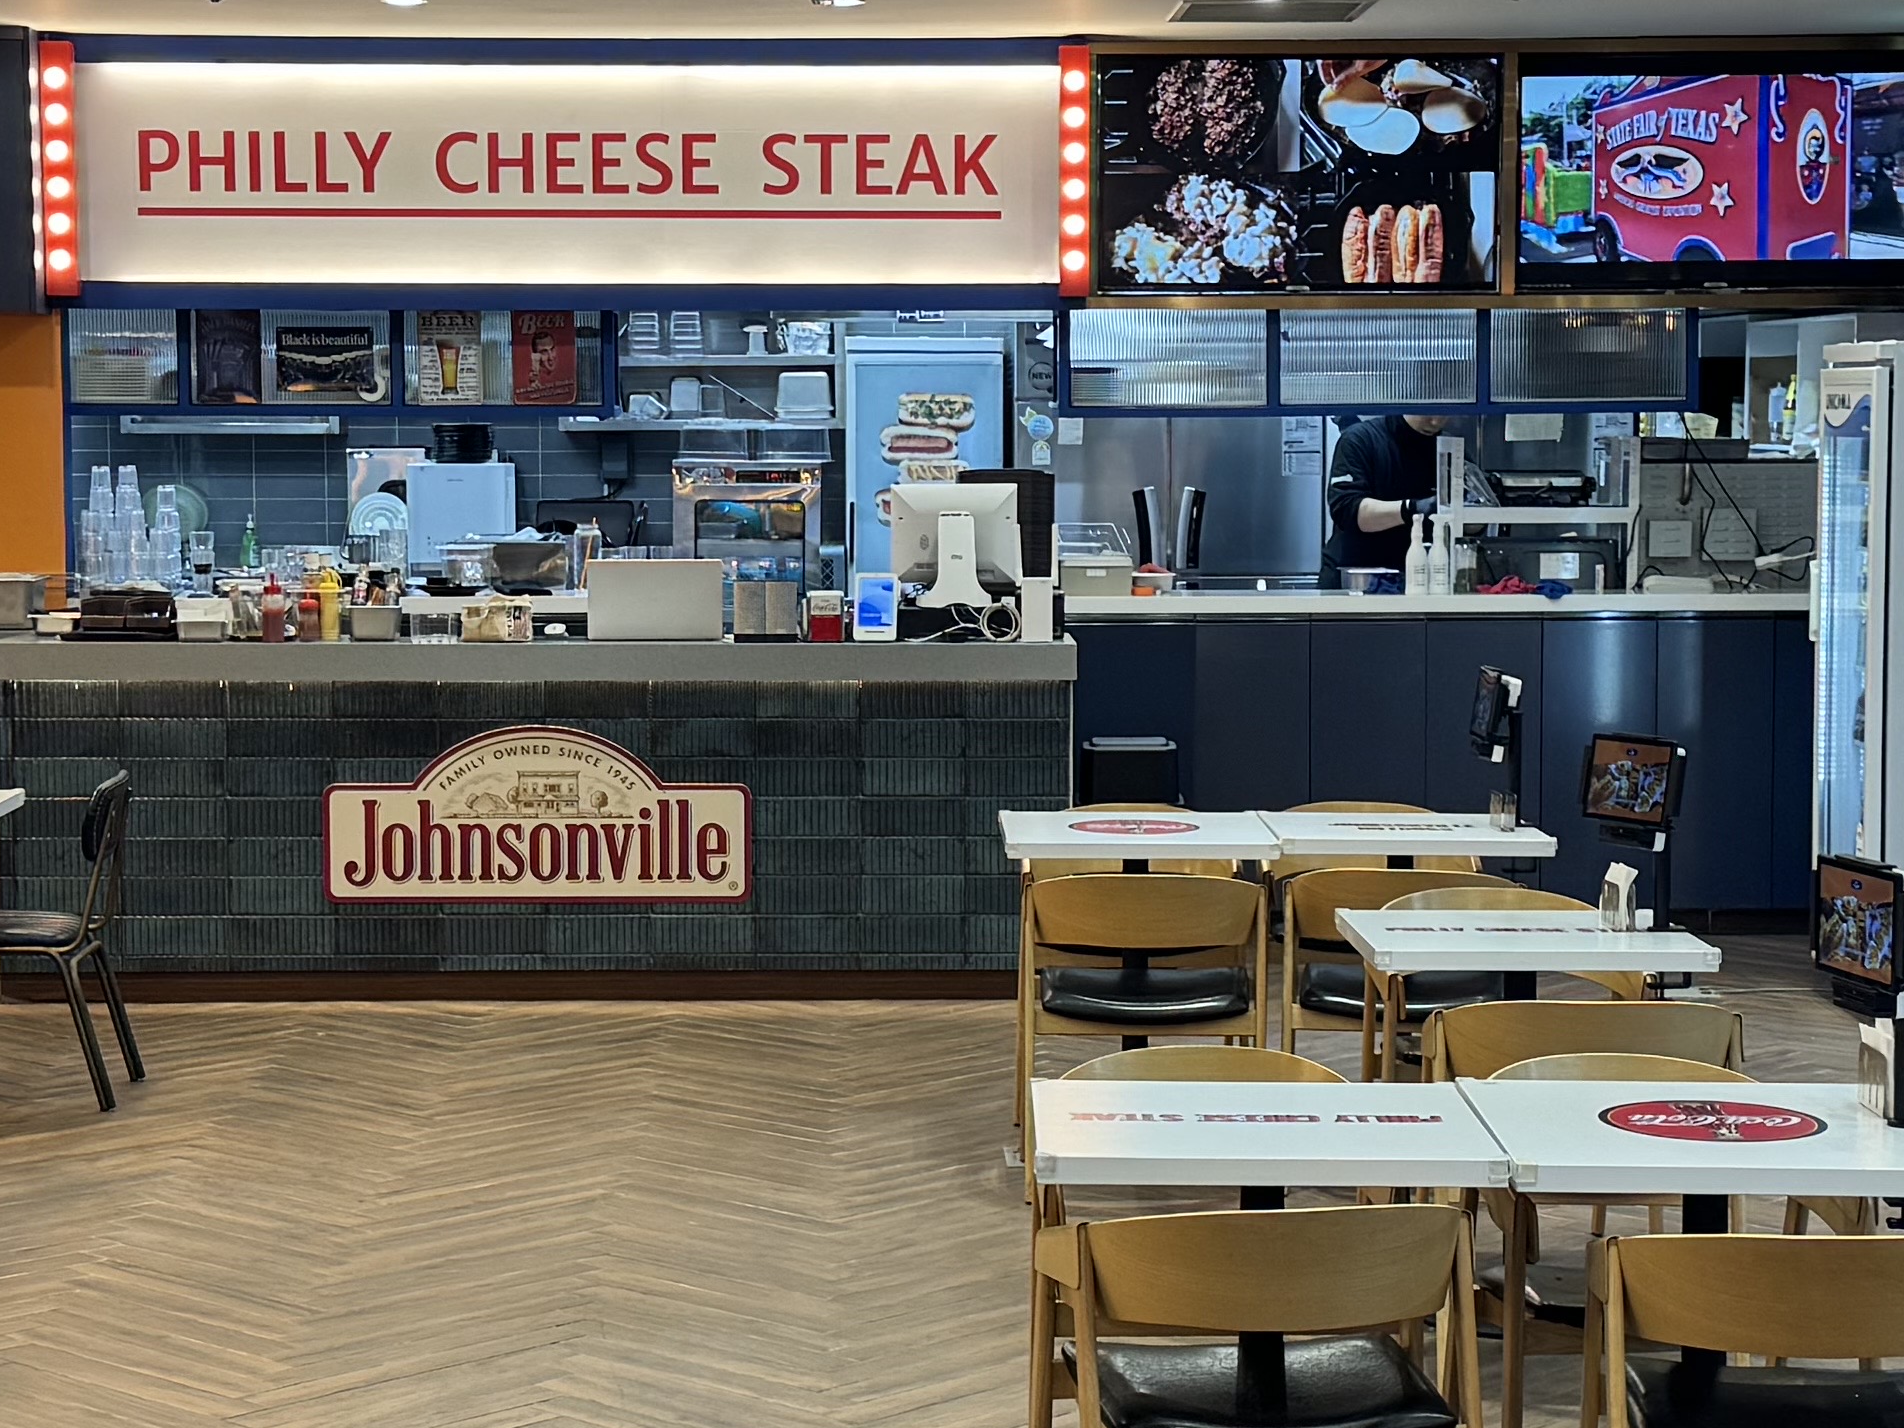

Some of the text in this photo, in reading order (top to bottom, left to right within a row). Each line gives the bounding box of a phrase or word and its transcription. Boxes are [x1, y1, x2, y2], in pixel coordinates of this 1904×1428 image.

[1668, 107, 1719, 143] TEXAS
[138, 129, 1000, 197] PHILLY CHEESE STEAK
[281, 333, 368, 346] Black is beautiful
[422, 316, 474, 327] BEER
[438, 744, 638, 792] FAMILY OWNED SINCE 1945
[343, 799, 731, 886] Johnsonville
